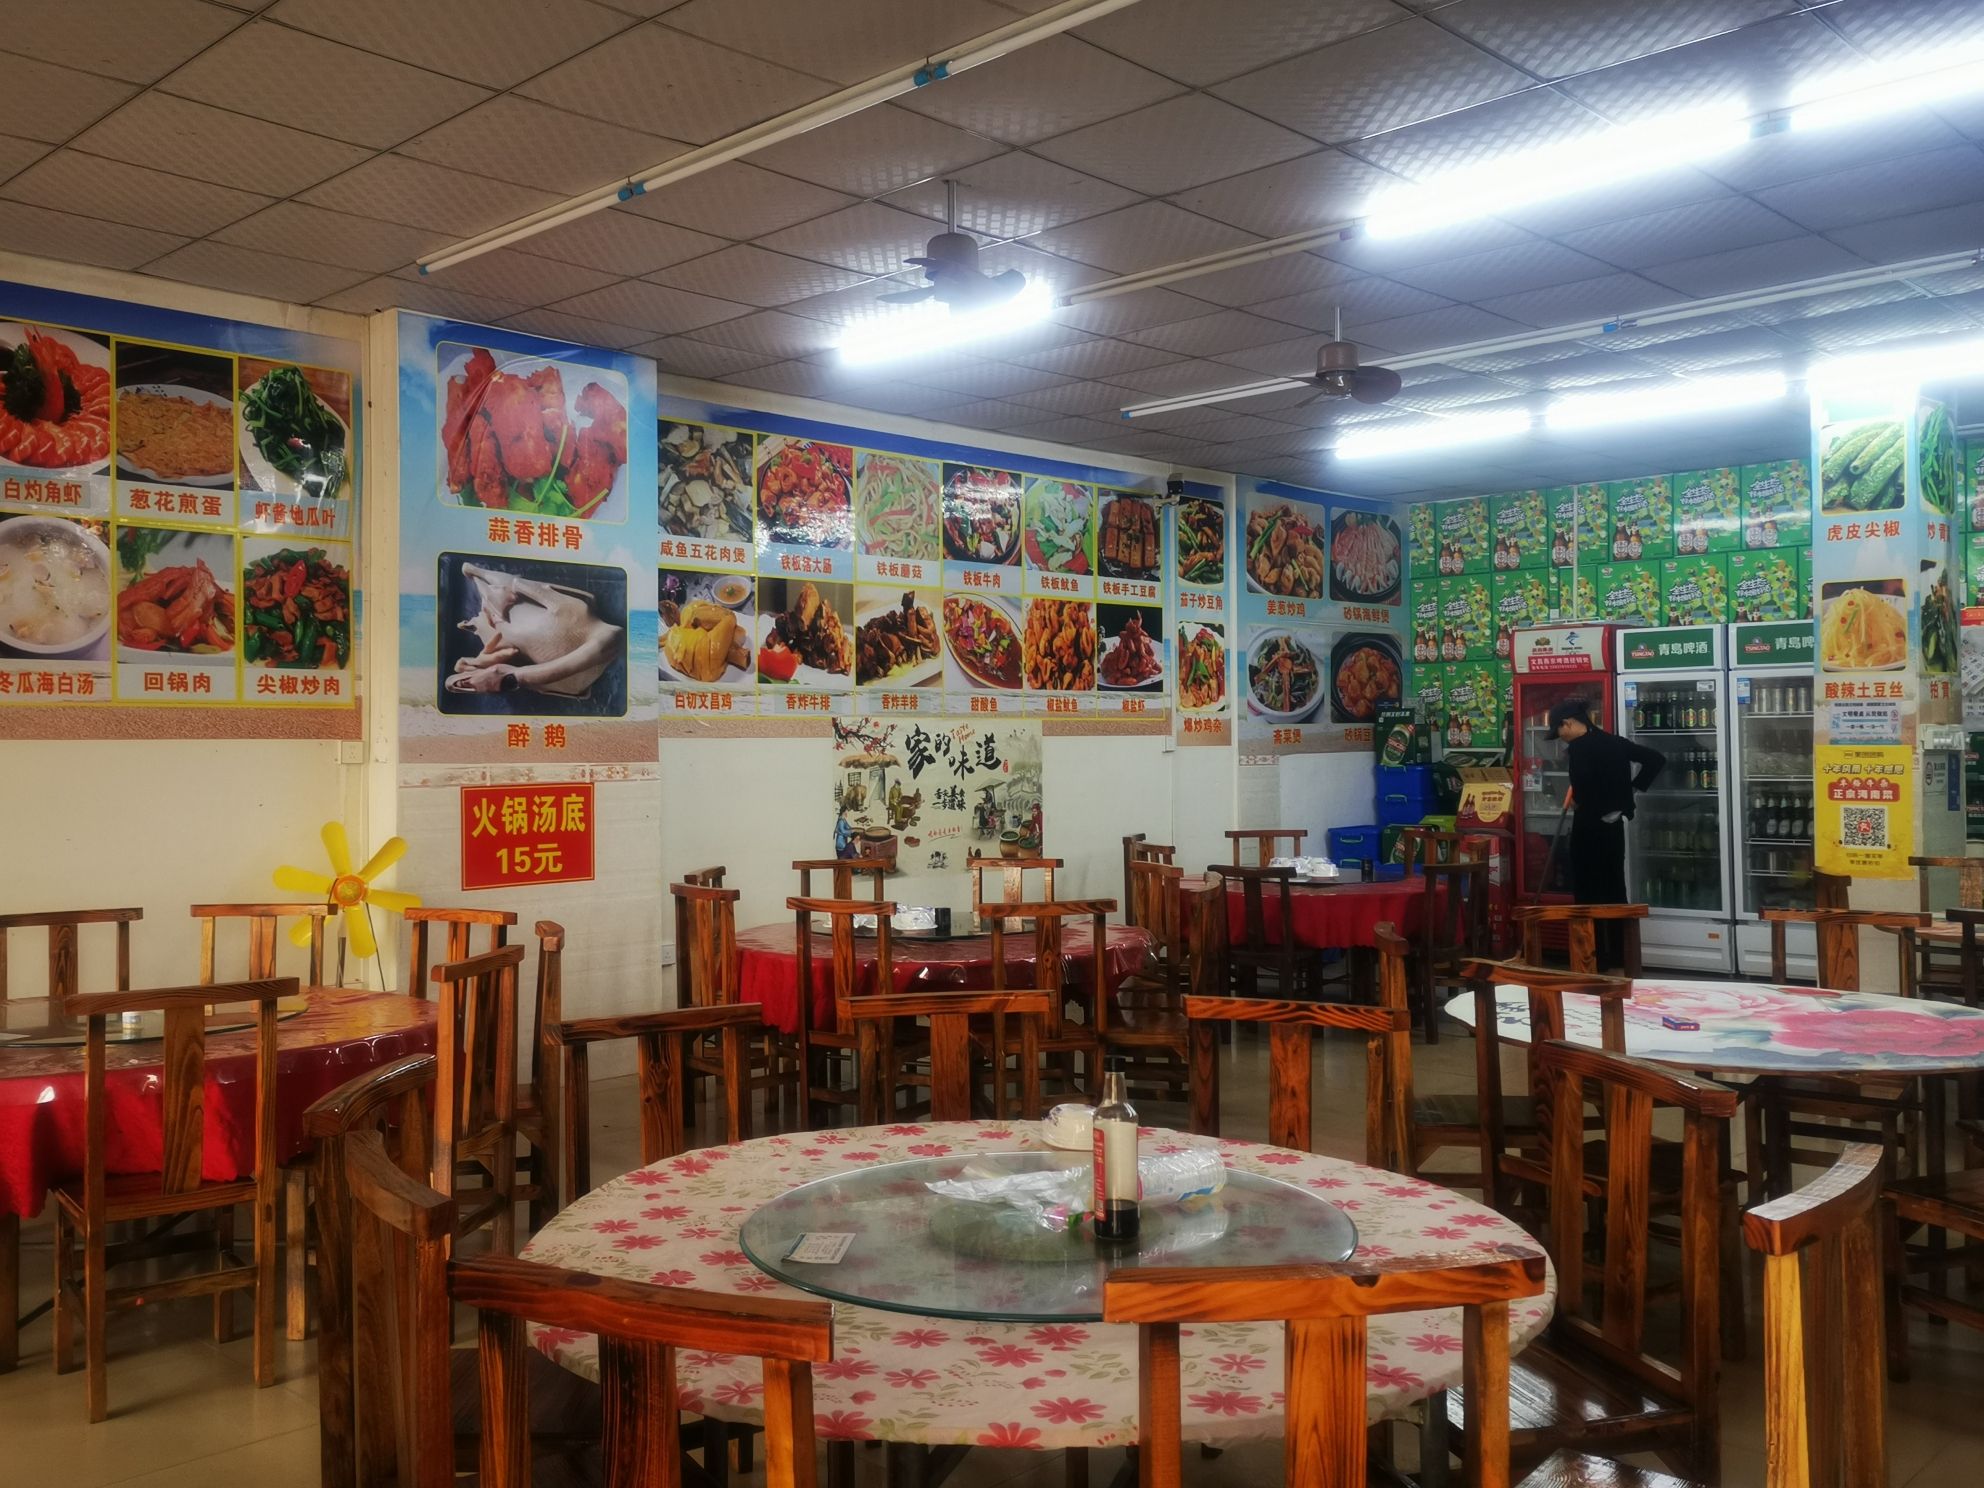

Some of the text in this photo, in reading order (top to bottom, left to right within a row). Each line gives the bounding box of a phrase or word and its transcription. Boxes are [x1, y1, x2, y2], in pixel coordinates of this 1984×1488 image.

[4, 478, 83, 505] 白灼角虾
[129, 488, 222, 516] 葱花煎蛋
[255, 501, 336, 528] 虾酱地瓜叶
[488, 517, 583, 550] 蒜香排骨
[1827, 520, 1900, 541] 虎皮尖椒
[1927, 523, 1951, 543] 炒青
[660, 540, 745, 563] 咸鱼五花肉煲
[877, 561, 922, 579] 铁板蘑菇
[963, 570, 1001, 588] 铁板牛肉
[1041, 575, 1079, 592] 铁板鱿鱼
[1103, 581, 1156, 598] 铁板手工豆腐
[1180, 592, 1223, 611] 茄子炒豆角
[1267, 600, 1306, 617] 姜葱炒鸡
[1343, 606, 1390, 624] 砂锅海鲜煲
[1658, 641, 1708, 656] 青岛啤酒
[0, 669, 94, 695] 冬瓜海白汤
[144, 671, 211, 693] 回锅肉
[257, 674, 340, 695] 尖椒炒肉
[1825, 681, 1904, 700] 酸辣土豆丝
[675, 692, 732, 710] 白切文昌鸡
[786, 693, 831, 710] 香炸牛排
[881, 693, 918, 710] 香炸羊排
[508, 724, 566, 748] 醉鹅
[905, 723, 1002, 781] 家的味道
[472, 793, 586, 837] 火锅汤底
[496, 844, 563, 874] 15元
